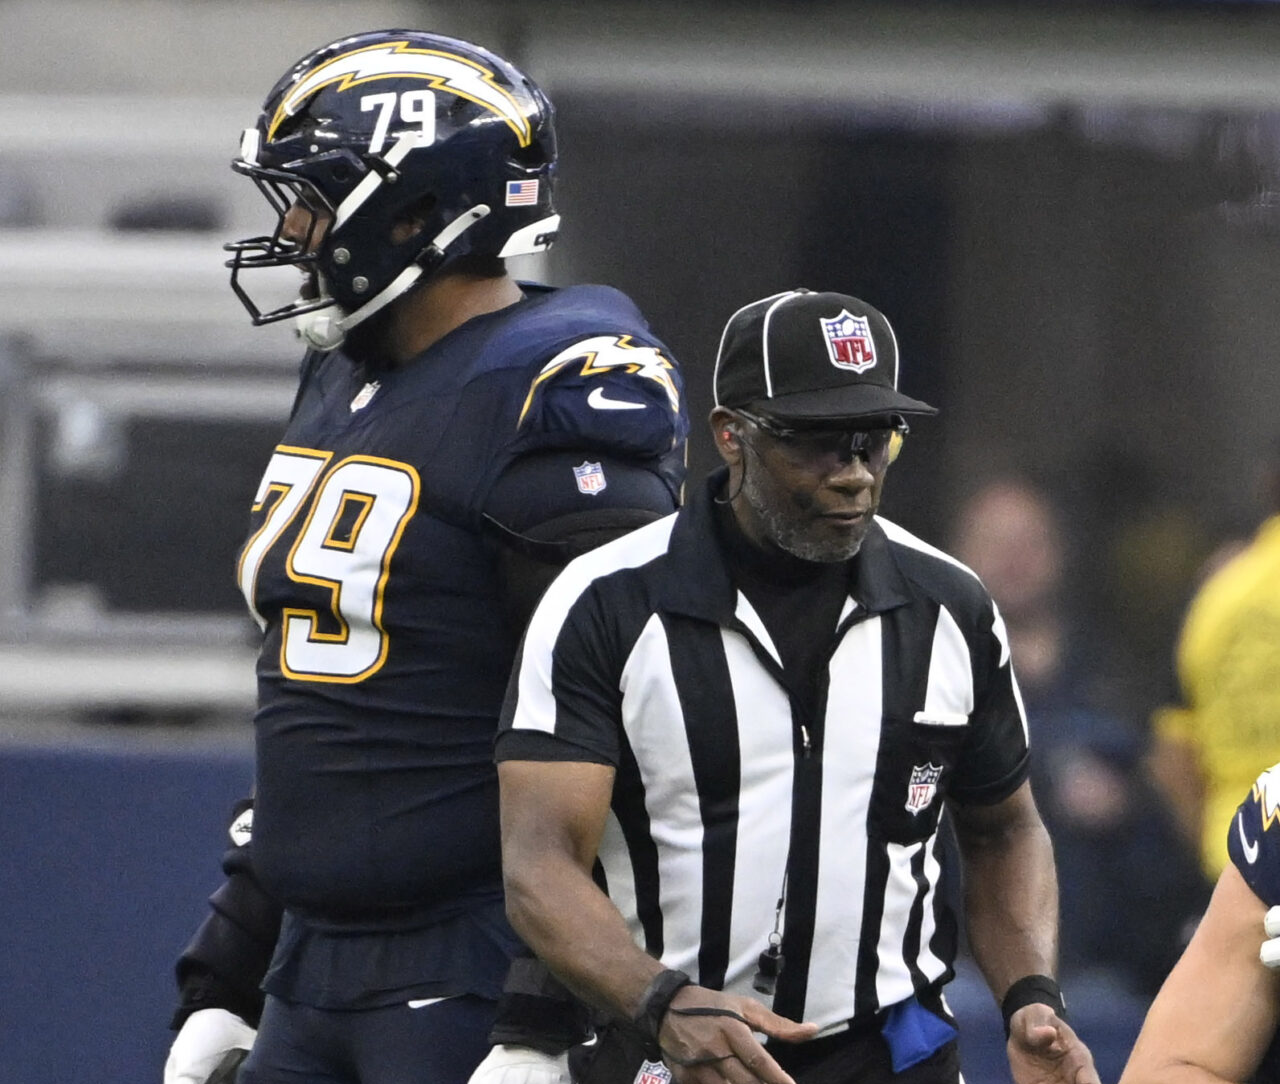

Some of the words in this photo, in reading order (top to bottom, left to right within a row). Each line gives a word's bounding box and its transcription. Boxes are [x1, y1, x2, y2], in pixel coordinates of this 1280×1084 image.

[361, 90, 436, 153] 79
[831, 339, 873, 365] NFL
[579, 473, 605, 490] NFL
[238, 445, 420, 684] 79
[908, 785, 933, 809] NFL
